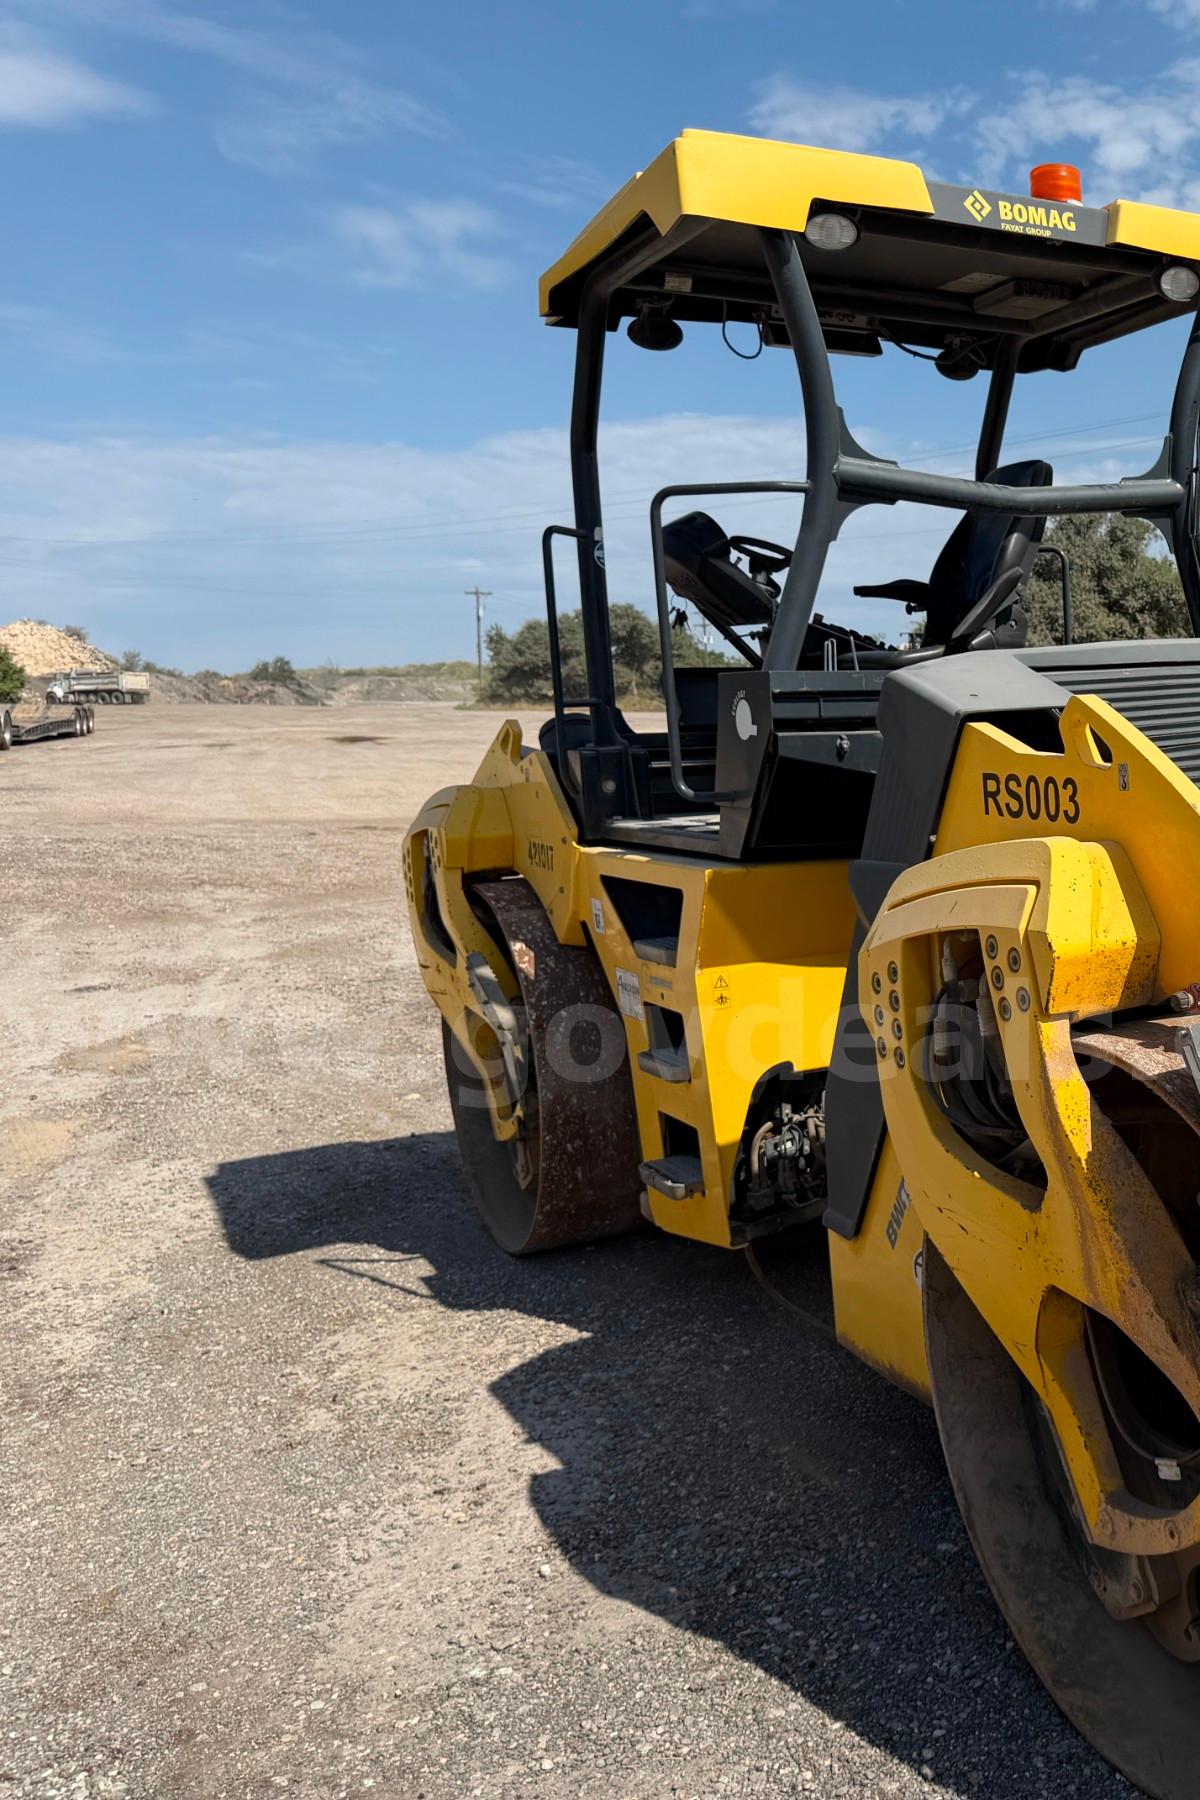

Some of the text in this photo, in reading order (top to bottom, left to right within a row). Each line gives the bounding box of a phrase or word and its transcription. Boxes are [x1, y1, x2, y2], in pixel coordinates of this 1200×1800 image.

[998, 201, 1077, 231] BOMAG
[1001, 222, 1051, 237] FAYAT GROUP
[982, 772, 1080, 824] RS003
